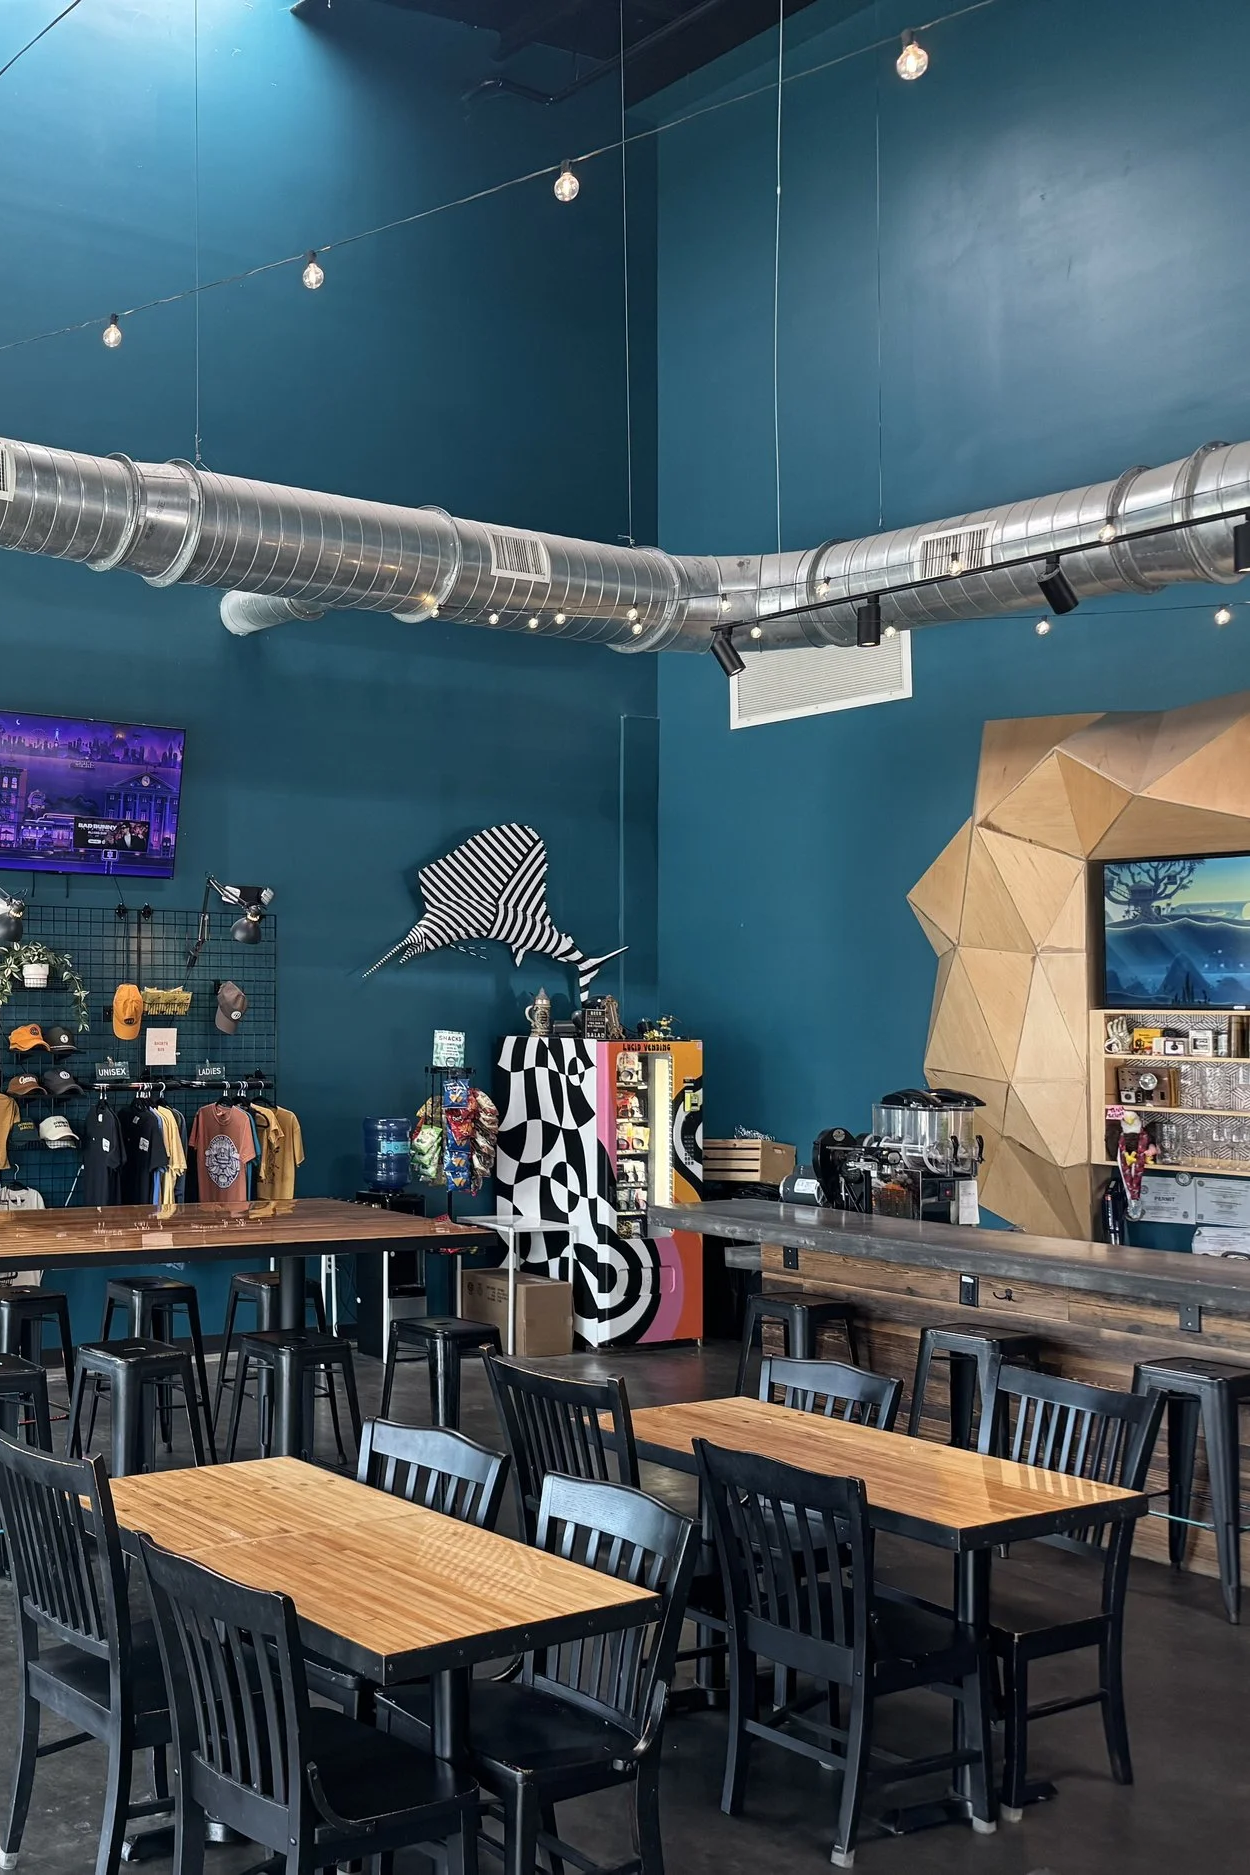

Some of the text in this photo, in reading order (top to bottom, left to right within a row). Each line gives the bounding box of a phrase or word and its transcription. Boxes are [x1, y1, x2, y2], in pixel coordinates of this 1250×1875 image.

[622, 1043, 671, 1052] LUCID VENDING
[98, 1067, 127, 1077] UNISEX
[198, 1067, 222, 1077] LADIES
